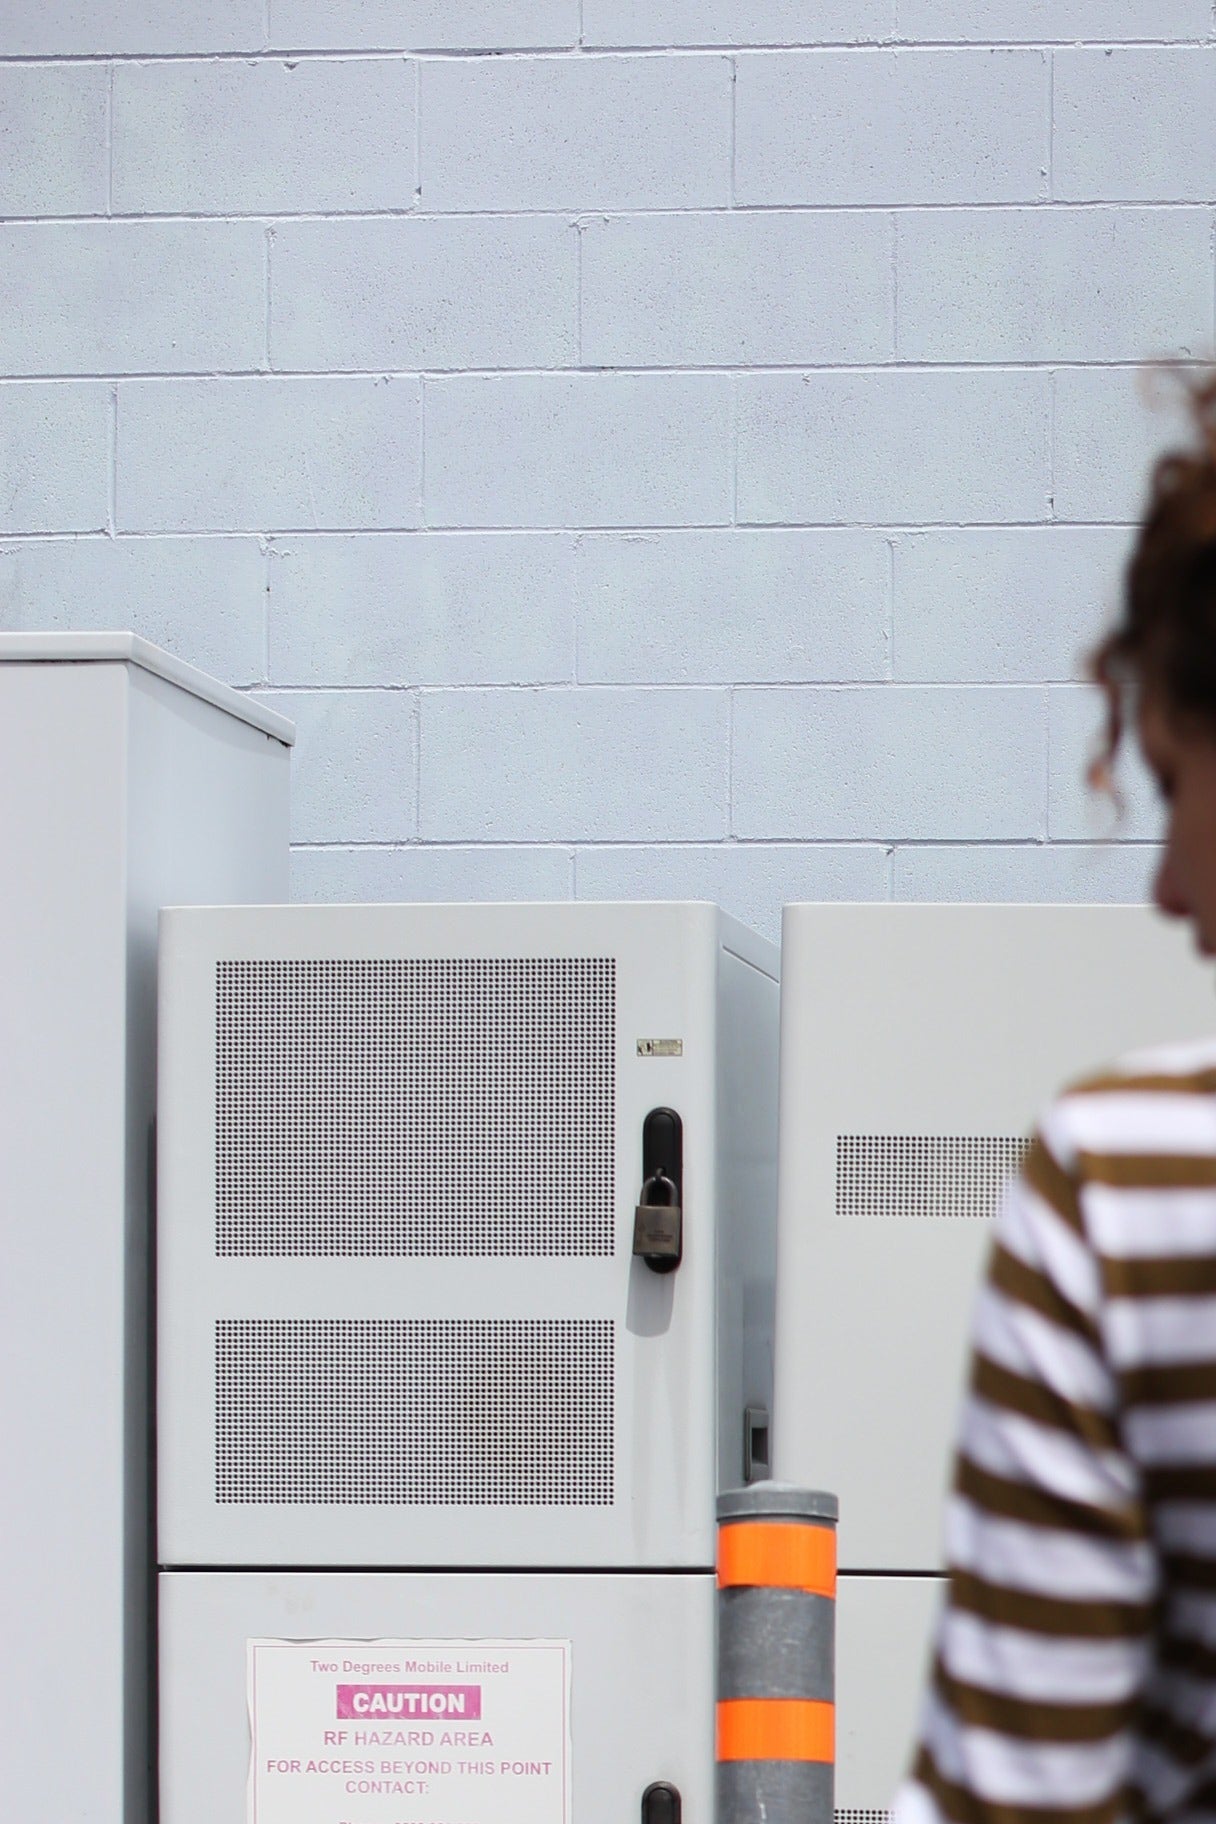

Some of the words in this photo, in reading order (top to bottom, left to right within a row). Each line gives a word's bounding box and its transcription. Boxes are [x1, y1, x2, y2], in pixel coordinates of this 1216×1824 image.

[310, 1660, 338, 1673] Two
[343, 1660, 400, 1676] Degrees
[405, 1660, 452, 1673] Mobile
[456, 1660, 509, 1673] Limited
[352, 1693, 465, 1713] CAUTION
[323, 1731, 348, 1746] RF
[354, 1731, 434, 1746] HAZARD
[440, 1732, 494, 1746] AREA
[267, 1761, 301, 1773] FOR
[306, 1761, 375, 1774] ACCESS
[381, 1761, 452, 1775] BEYOND
[458, 1761, 495, 1775] THIS
[500, 1761, 552, 1776] POINT
[345, 1780, 429, 1794] CONTACT:
